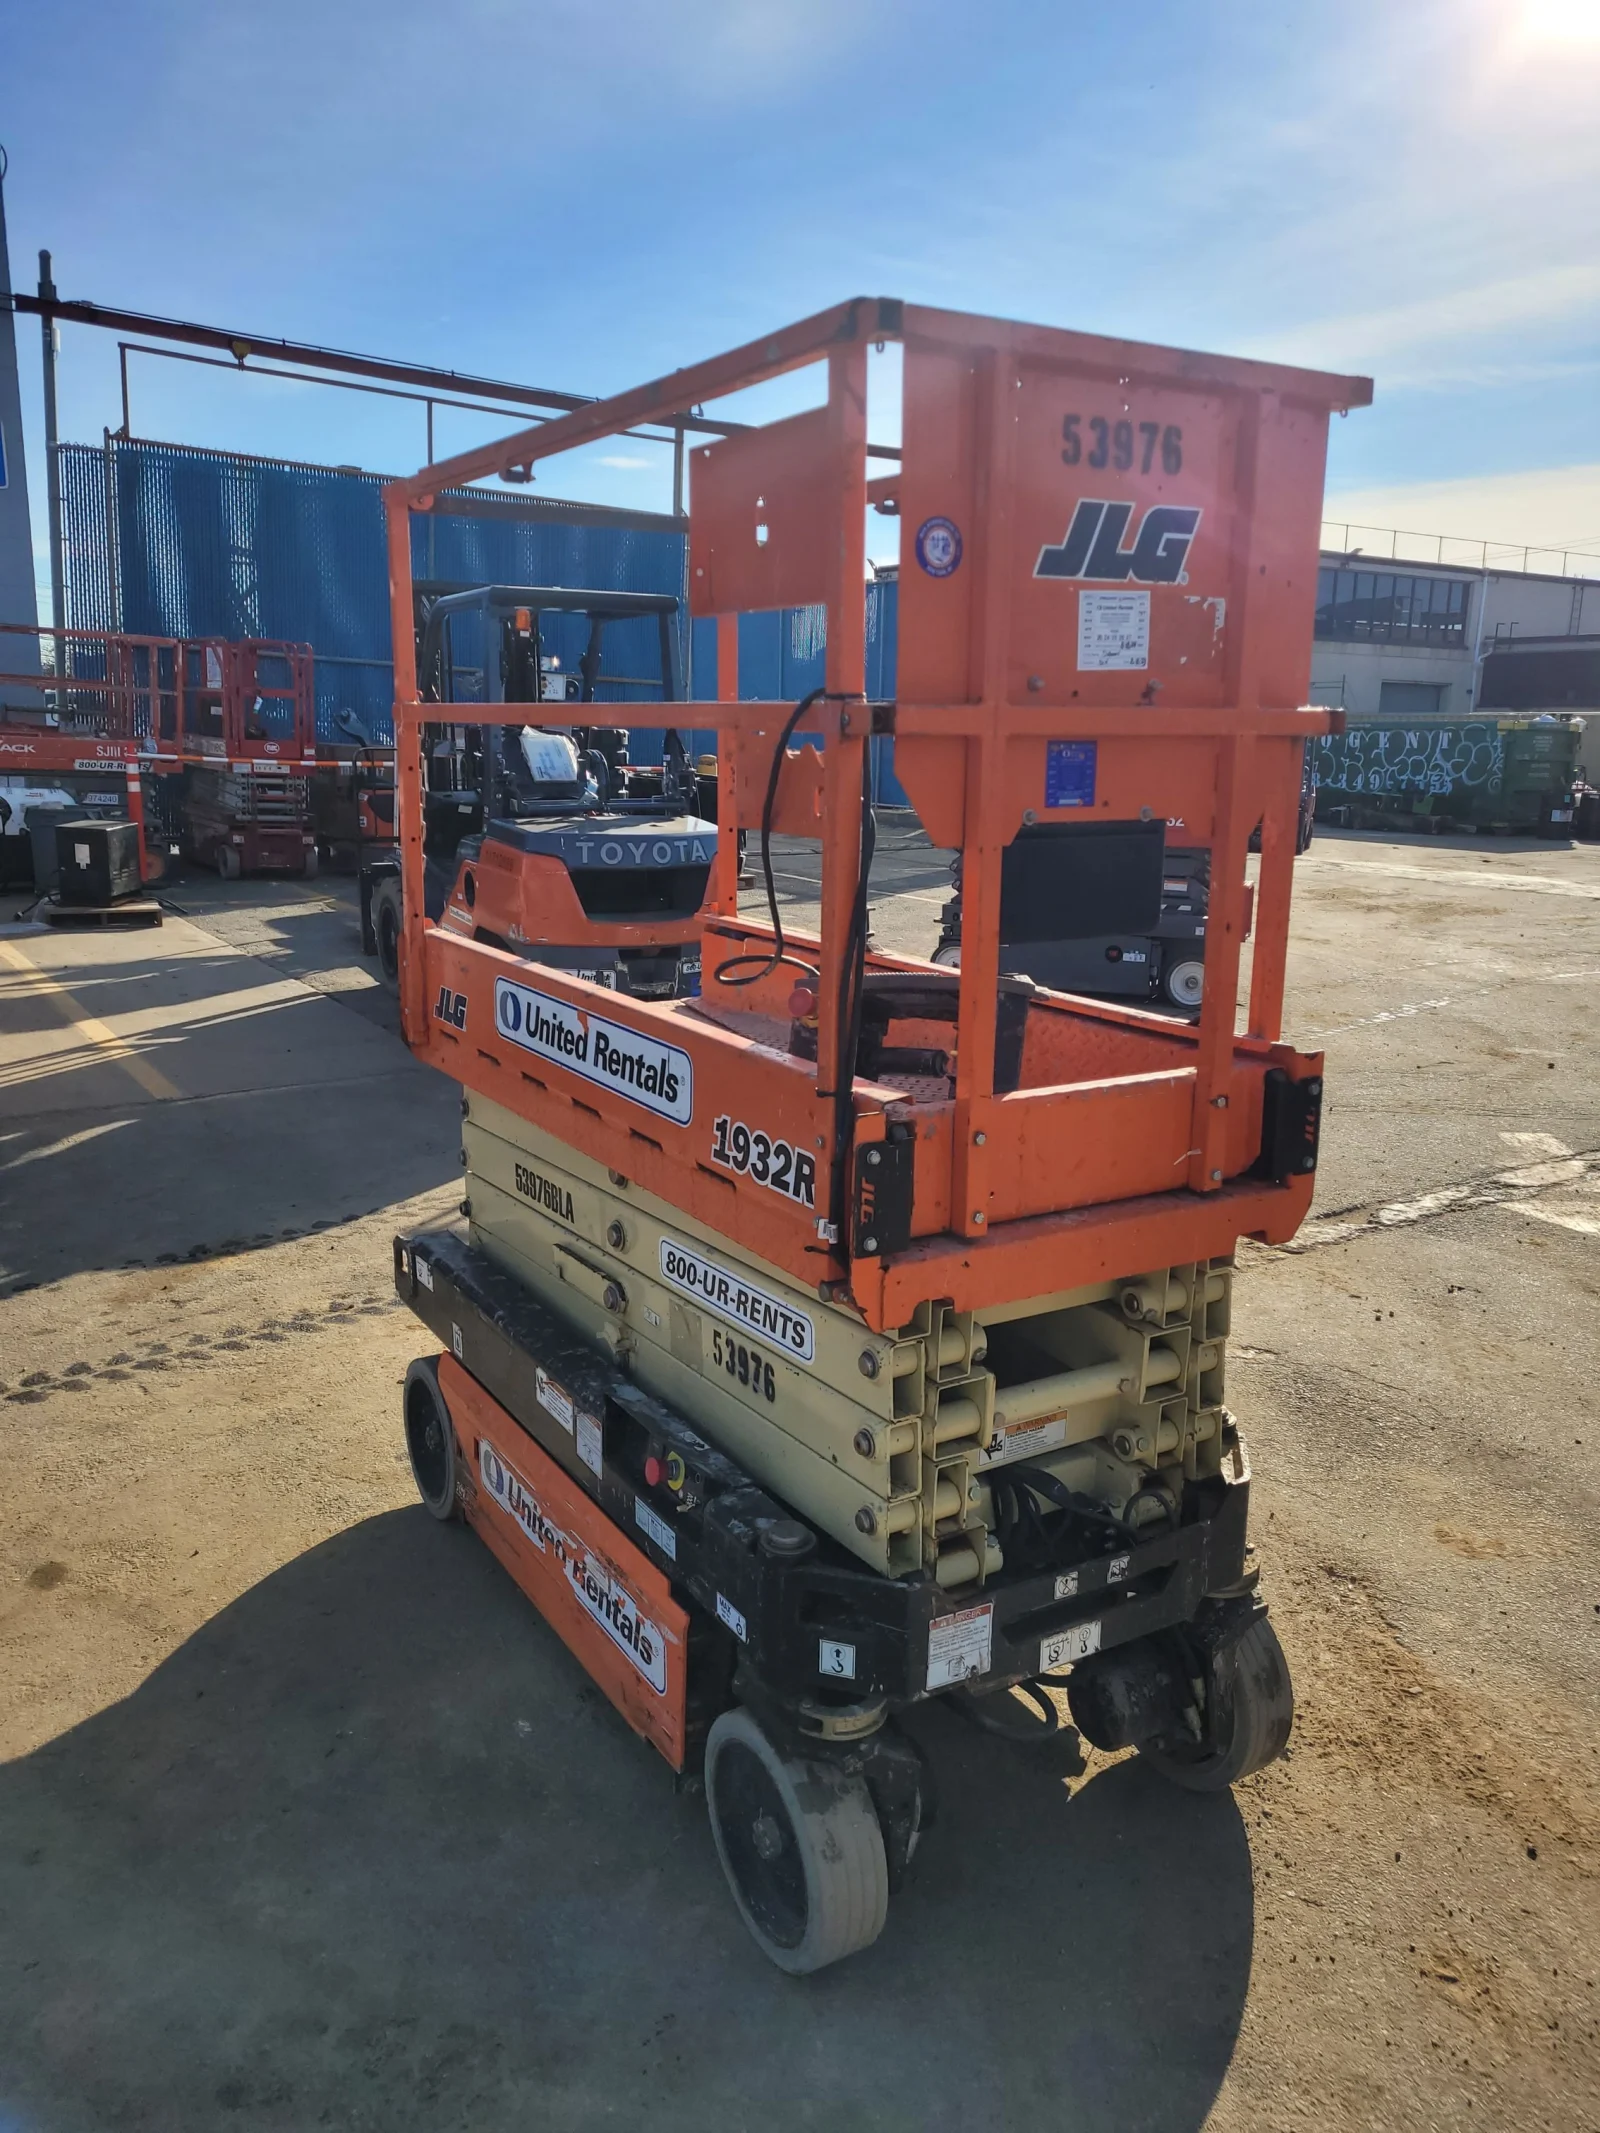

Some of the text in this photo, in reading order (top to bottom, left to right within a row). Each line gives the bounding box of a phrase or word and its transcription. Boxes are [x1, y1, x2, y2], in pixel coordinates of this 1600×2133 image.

[1061, 413, 1184, 476] 53976
[1033, 498, 1203, 584] JLG
[0, 743, 36, 753] ACK
[78, 760, 151, 772] 800-UR-RTS
[576, 839, 708, 864] TOYOTA
[434, 985, 468, 1032] JLG
[525, 1005, 680, 1103] United Rentals
[513, 1163, 575, 1224] 53976BLA
[713, 1115, 815, 1209] 1932R
[665, 1250, 807, 1350] 800-UR-RENTS
[712, 1329, 776, 1402] 53976
